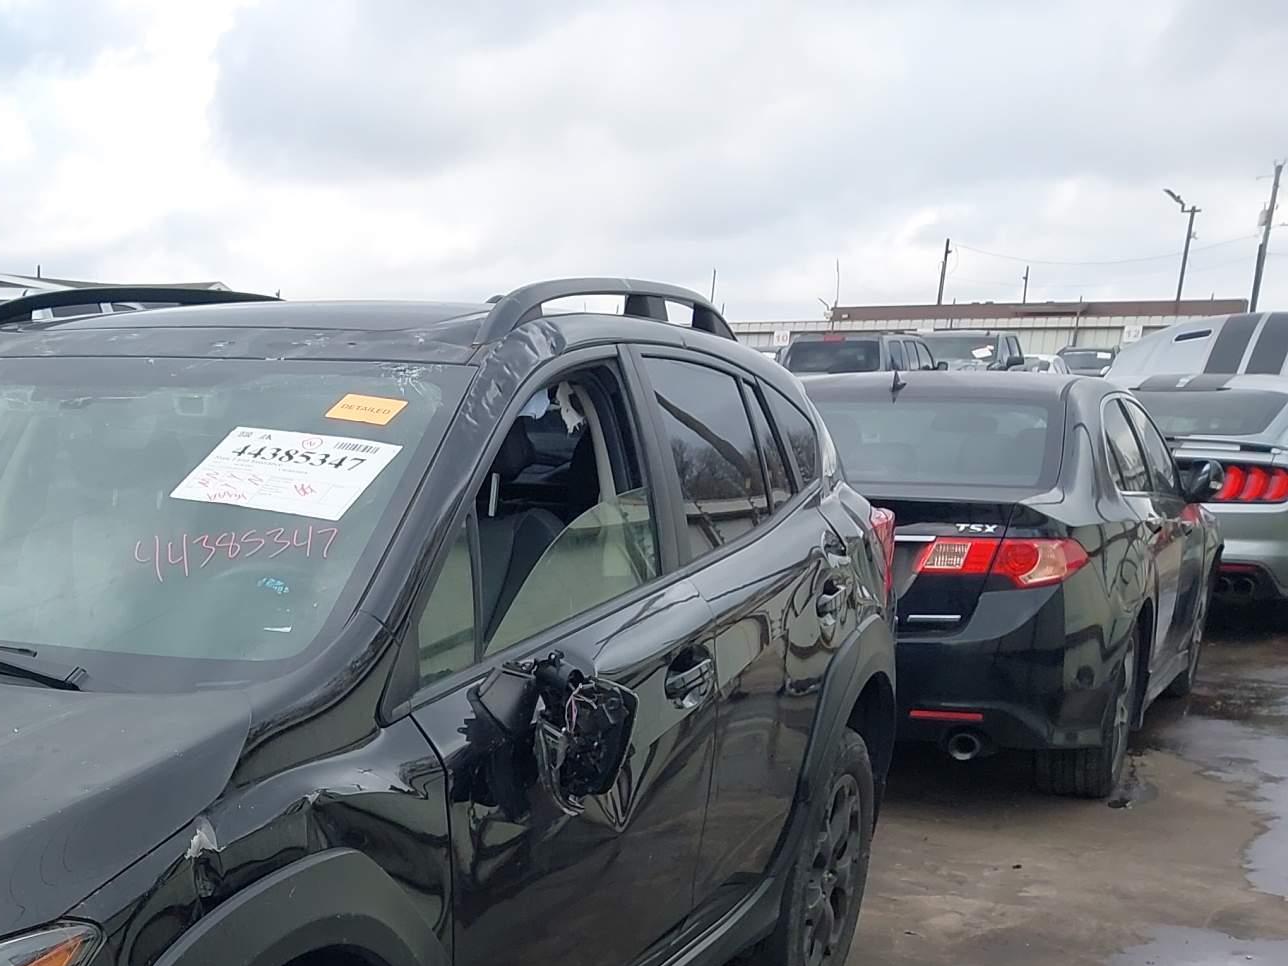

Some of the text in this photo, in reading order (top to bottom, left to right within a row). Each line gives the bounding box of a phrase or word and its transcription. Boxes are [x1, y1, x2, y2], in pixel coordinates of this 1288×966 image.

[341, 404, 391, 414] DETAILED
[232, 445, 366, 471] 44385347
[955, 523, 998, 533] TSX
[134, 526, 338, 583] 44385347
